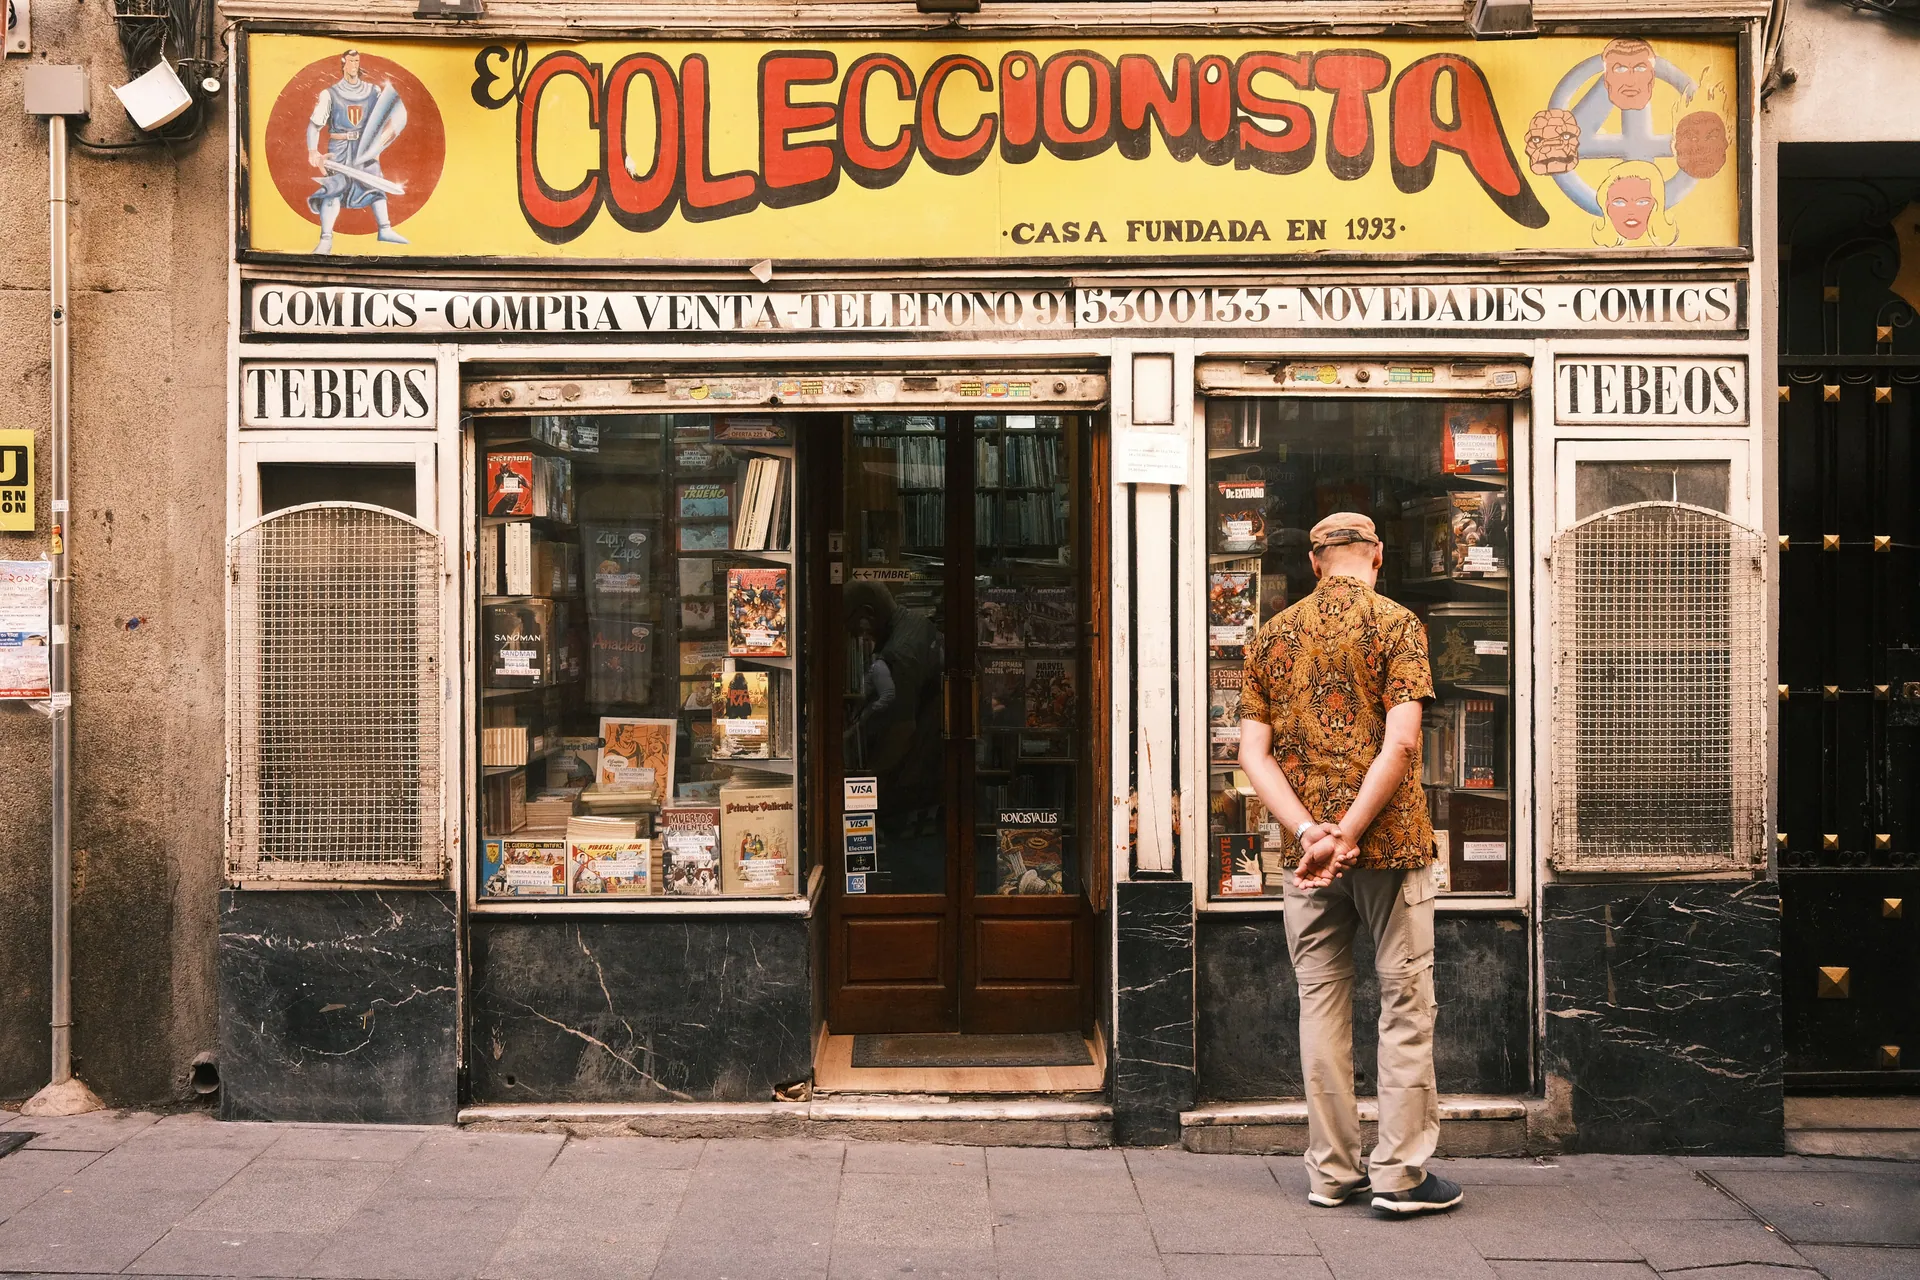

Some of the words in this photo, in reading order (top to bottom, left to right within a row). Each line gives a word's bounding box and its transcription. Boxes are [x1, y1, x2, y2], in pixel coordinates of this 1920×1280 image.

[471, 40, 528, 110] El
[516, 48, 1550, 244] COLECCIONISTA
[1127, 219, 1271, 242] FUNDADA
[1286, 219, 1327, 241] EN
[247, 368, 430, 419] TEBEOS
[1560, 364, 1739, 415] TEBEOS
[684, 489, 726, 499] TRUENO
[1235, 486, 1264, 499] EXTRAÑO
[596, 530, 619, 548] Zipi
[610, 545, 642, 562] Zape
[872, 570, 910, 578] TIMBRE
[592, 632, 646, 652] Anacleto
[1220, 679, 1243, 688] HIER
[850, 786, 872, 794] VISA
[760, 801, 794, 812] Valiente
[669, 812, 714, 824] MUERTOS
[1000, 812, 1058, 824] RONCESVALLES
[1248, 836, 1254, 849] 1
[1220, 836, 1232, 894] PARASYTE
